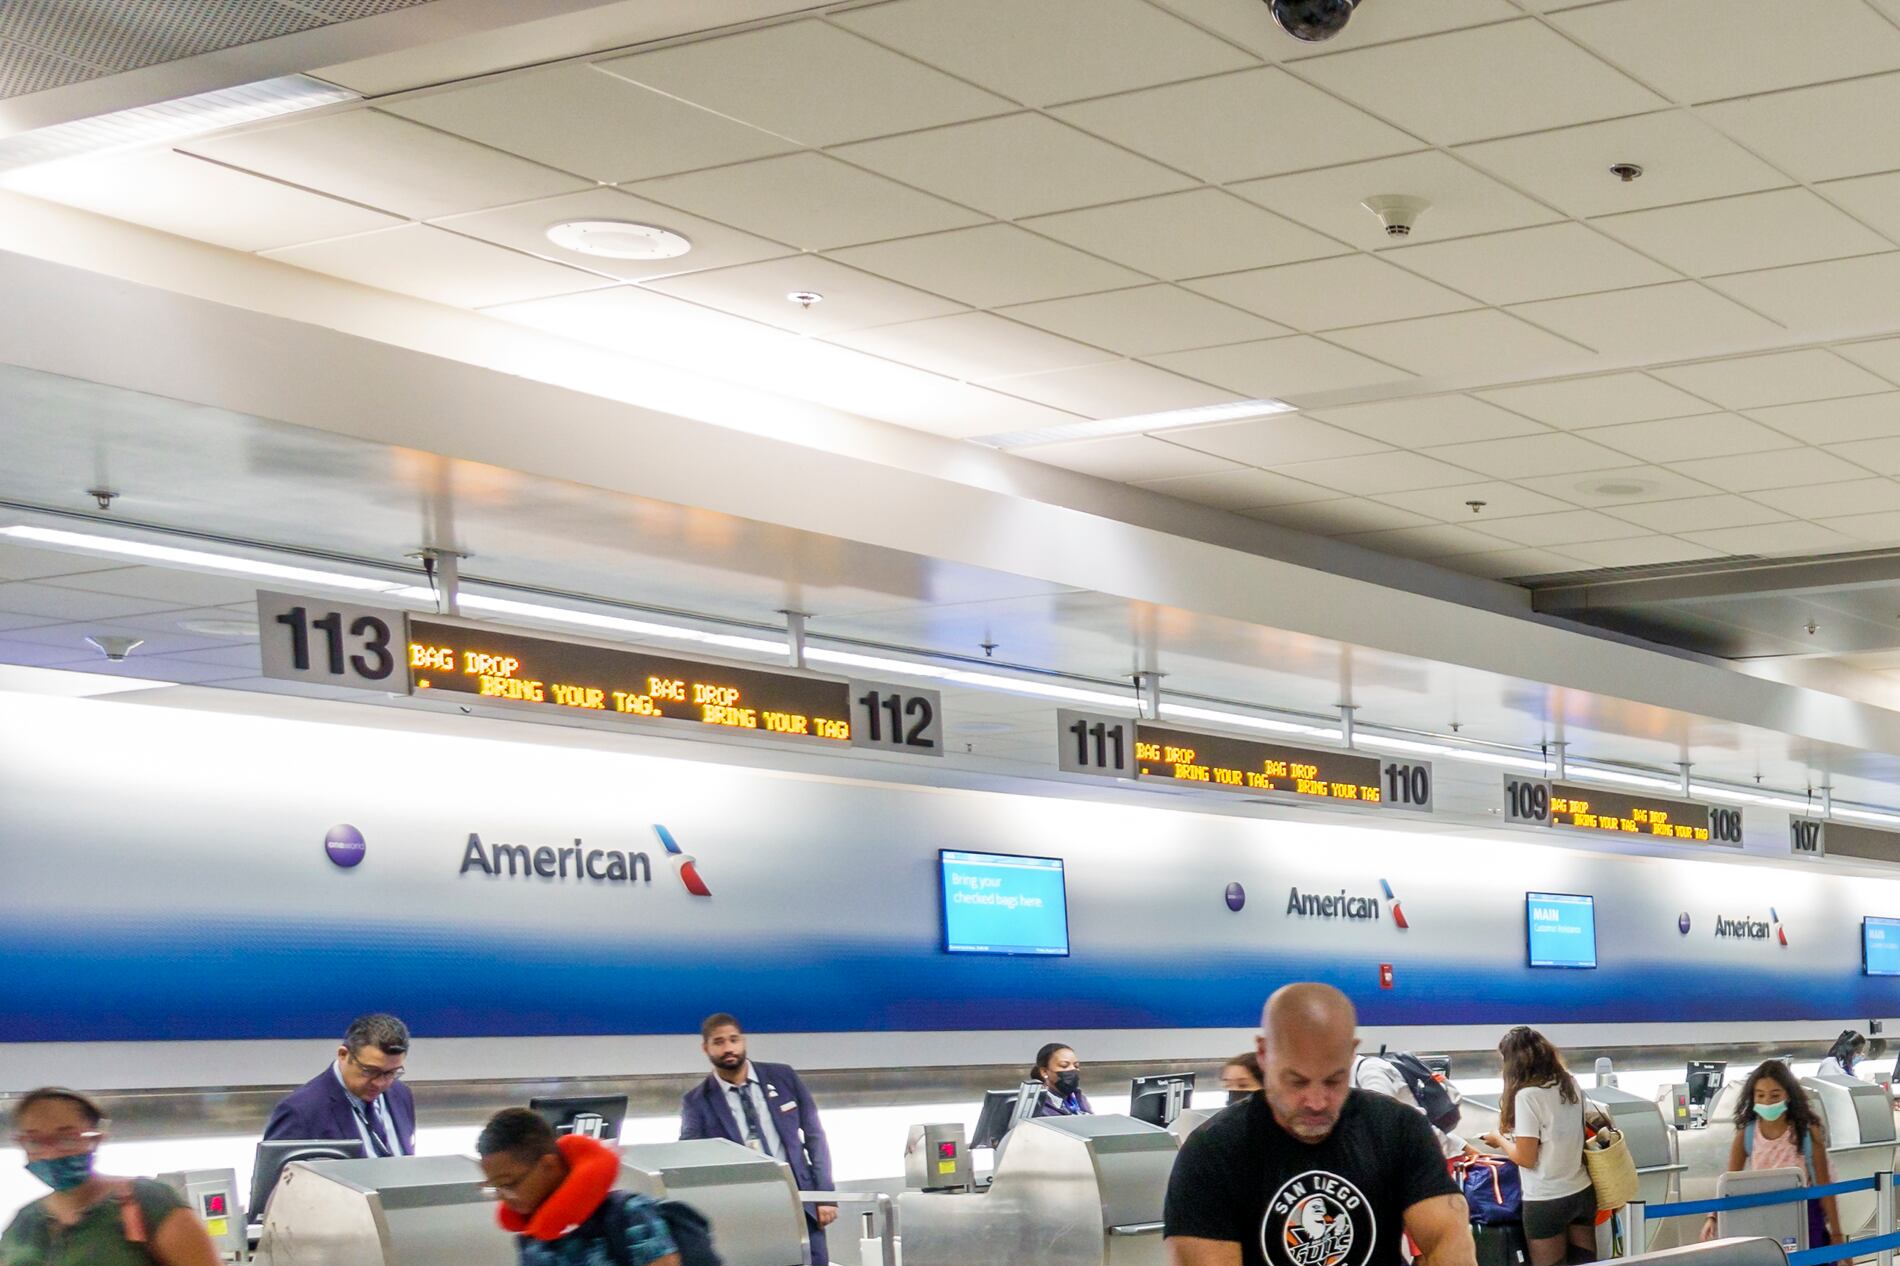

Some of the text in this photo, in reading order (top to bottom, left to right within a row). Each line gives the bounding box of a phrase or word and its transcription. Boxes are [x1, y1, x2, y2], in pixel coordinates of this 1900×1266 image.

[276, 606, 394, 680] 113
[409, 644, 519, 677] BAG DROP
[479, 674, 544, 703] BRING
[551, 683, 606, 710] YOUR
[648, 676, 740, 707] BAG DROP
[703, 703, 850, 740] BRING YOUR TAG
[859, 690, 934, 748] 112
[1070, 719, 1124, 770] 111
[1135, 742, 1196, 764] BAG DROP
[1174, 763, 1209, 782] BRING
[1213, 768, 1243, 786] YOUR
[1265, 759, 1318, 779] BAG DROP
[1385, 763, 1429, 806] 110
[1296, 778, 1380, 802] BRING YOUR TAG
[1507, 780, 1547, 820] 109
[1710, 808, 1742, 842] 108
[1792, 819, 1819, 852] 107
[460, 833, 651, 881] American
[952, 873, 1002, 889] Bring your
[953, 891, 995, 905] checked
[1286, 886, 1379, 920] American
[1533, 907, 1559, 922] MAIN
[1714, 914, 1771, 939] American
[1275, 1181, 1308, 1215] SAN
